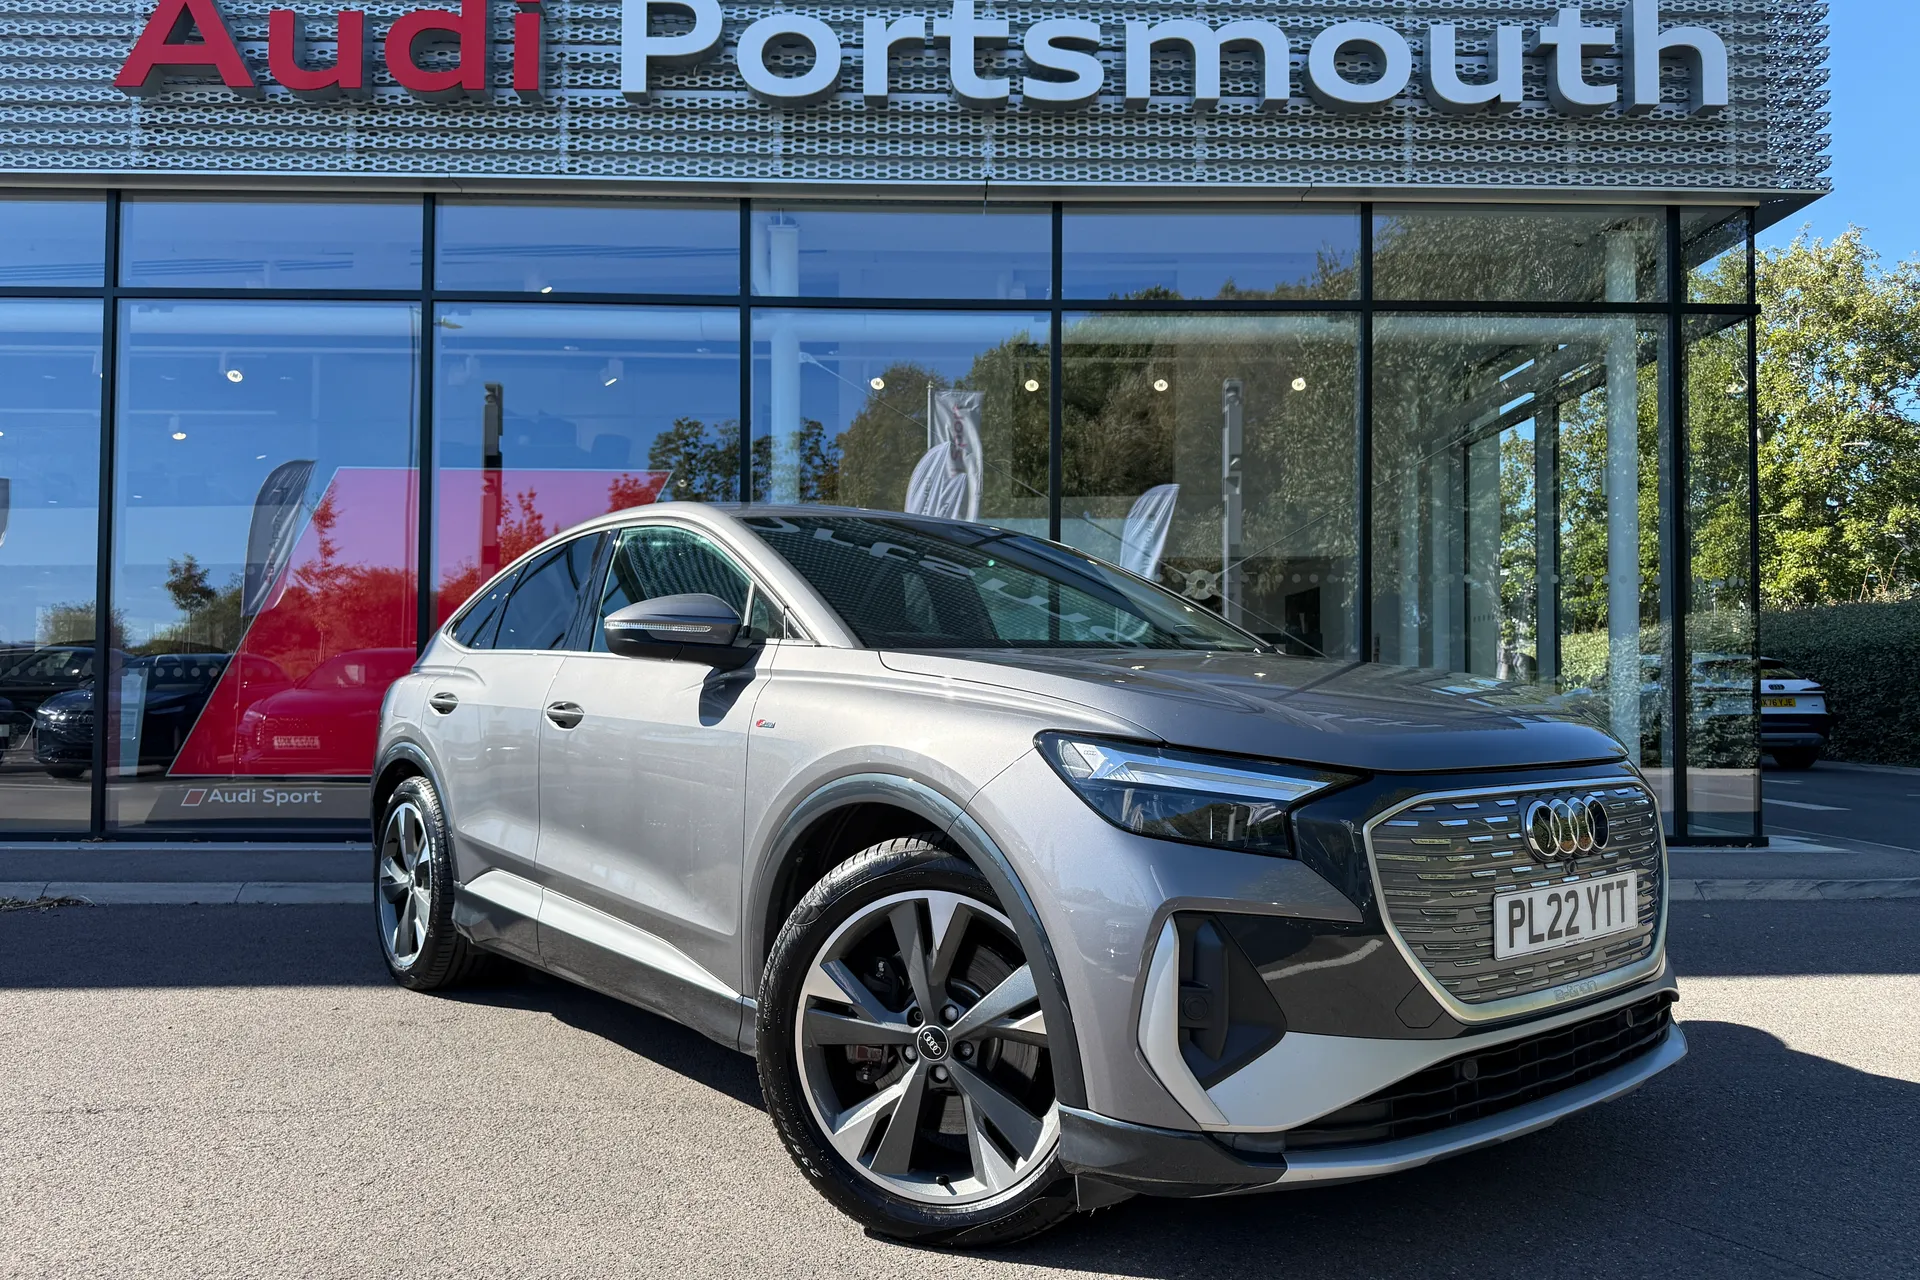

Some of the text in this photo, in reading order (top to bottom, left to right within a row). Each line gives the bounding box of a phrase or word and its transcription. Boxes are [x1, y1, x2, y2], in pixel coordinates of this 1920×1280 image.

[115, 0, 1729, 110] Audi Portsmouth
[207, 788, 322, 806] Audi Sport
[1508, 878, 1628, 948] PL22 YTT
[1553, 979, 1598, 1001] e-tron
